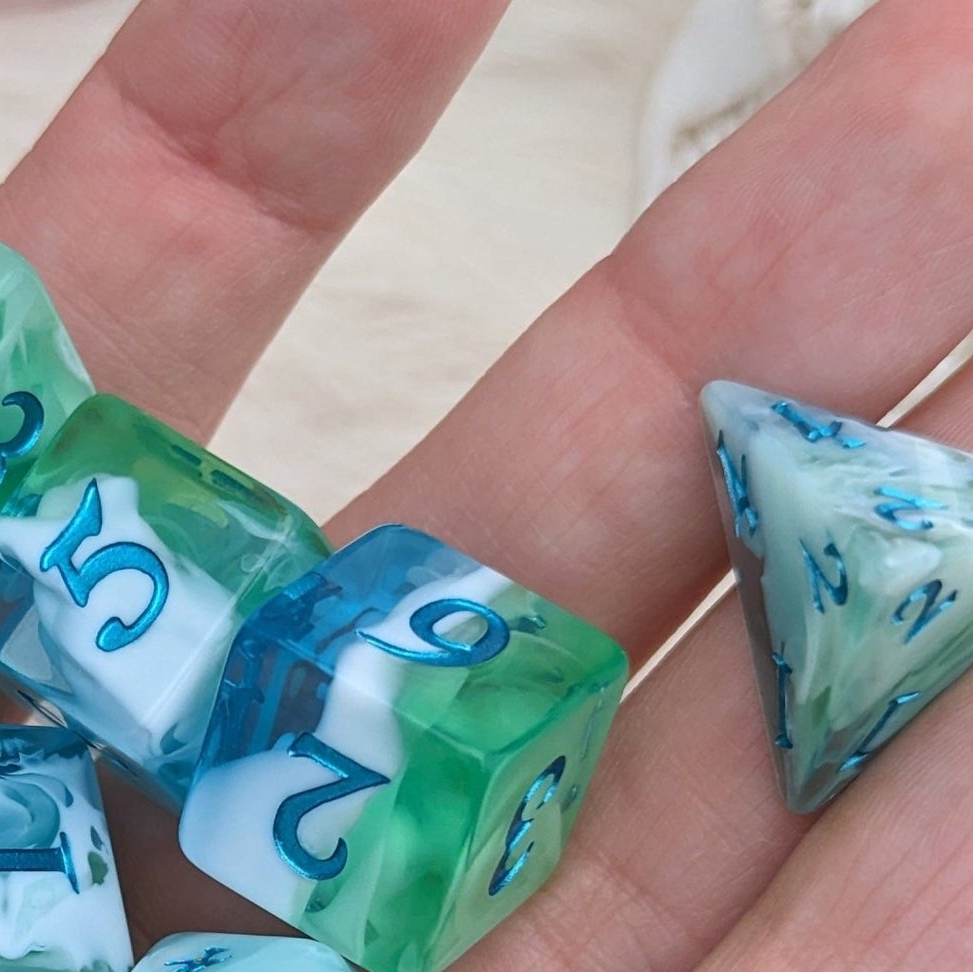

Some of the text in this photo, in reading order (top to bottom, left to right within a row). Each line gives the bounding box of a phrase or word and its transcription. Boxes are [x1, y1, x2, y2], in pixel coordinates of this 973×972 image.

[39, 478, 169, 652] 5
[800, 536, 849, 614] 2
[891, 579, 958, 646] 2
[272, 731, 392, 881] 2
